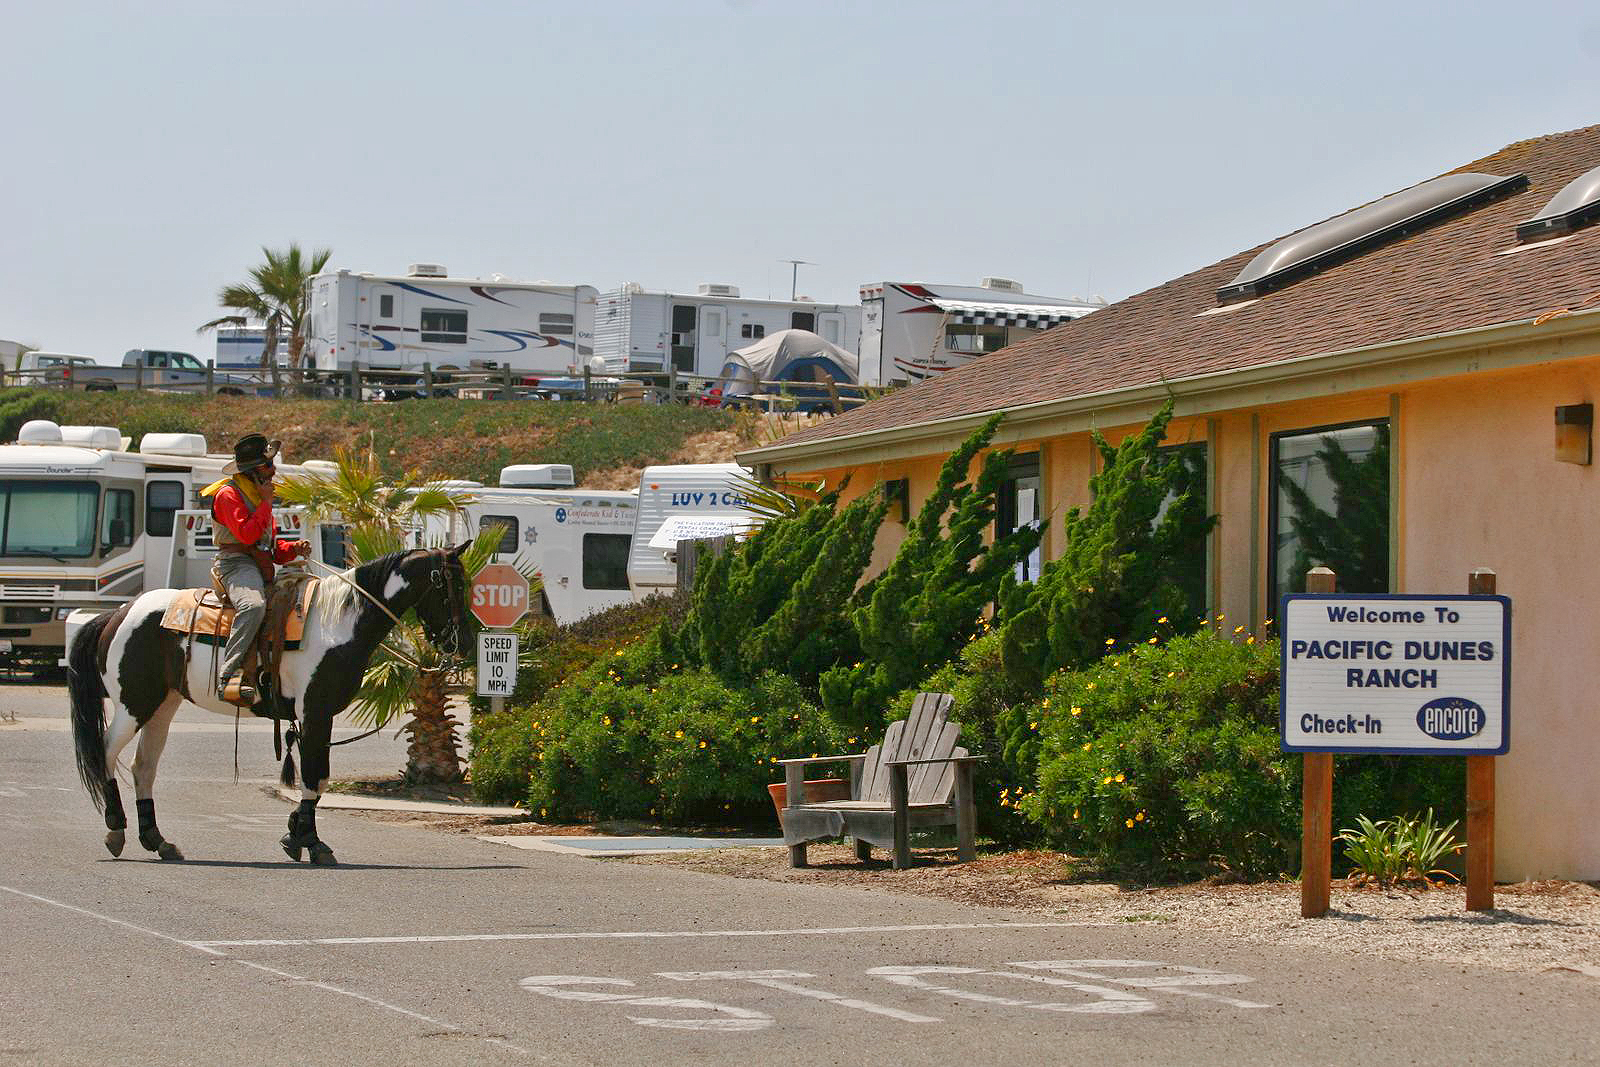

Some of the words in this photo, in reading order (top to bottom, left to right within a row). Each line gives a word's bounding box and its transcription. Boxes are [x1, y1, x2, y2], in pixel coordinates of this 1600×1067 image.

[672, 493, 703, 506] LUV
[709, 493, 718, 506] 2
[473, 584, 525, 606] STOP
[1327, 606, 1426, 624] Welcome
[1434, 607, 1461, 624] To
[484, 638, 512, 650] SPEED
[1291, 640, 1393, 661] PACIFIC
[1404, 641, 1495, 662] DUNES
[486, 652, 510, 664] LIMIT
[492, 666, 504, 679] 10
[1346, 668, 1438, 689] RANCH
[488, 680, 508, 693] MPH
[1300, 713, 1382, 734] Check-In
[1424, 707, 1479, 735] encore
